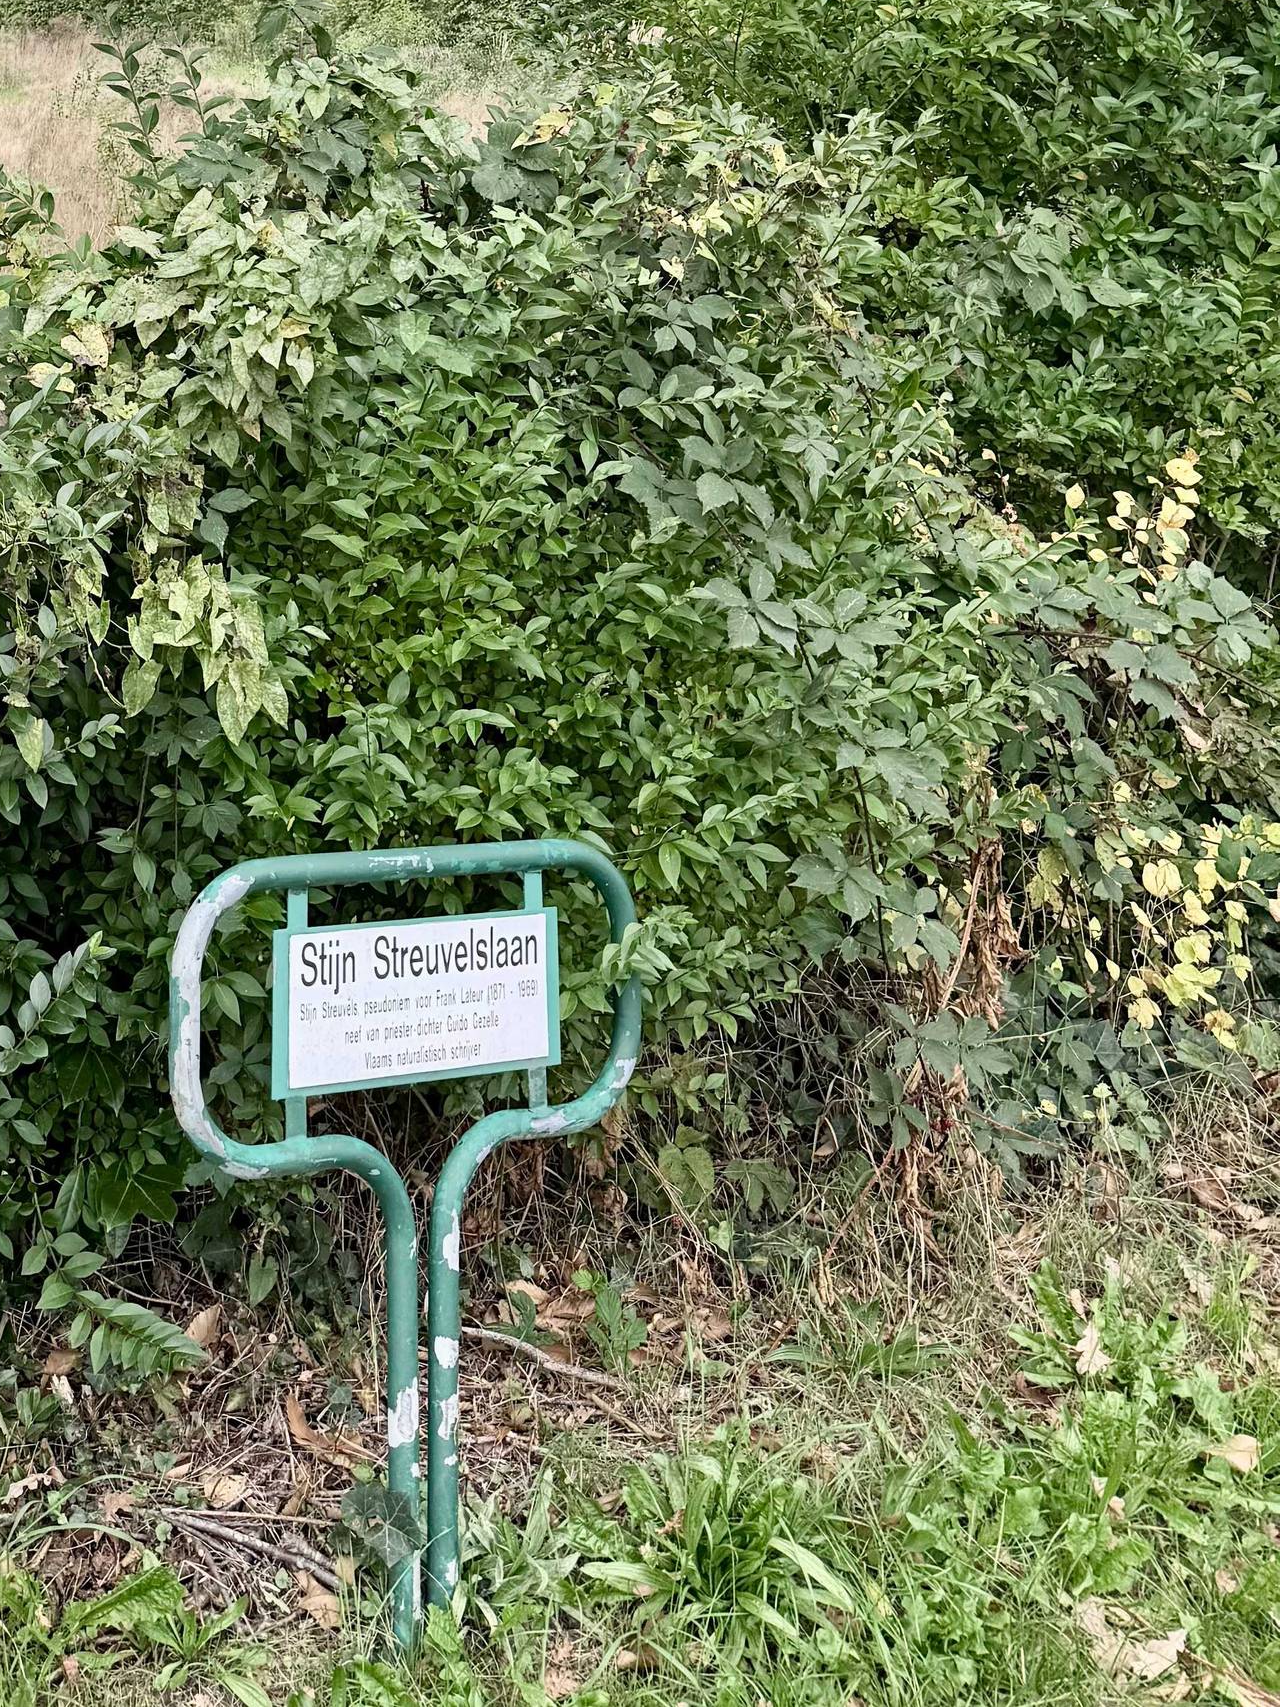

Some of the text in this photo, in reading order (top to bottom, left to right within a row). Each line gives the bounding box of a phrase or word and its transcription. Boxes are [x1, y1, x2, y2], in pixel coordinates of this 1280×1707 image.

[301, 926, 538, 995] Stijn Streuvelslaan
[300, 1003, 317, 1026] Stijn
[364, 993, 410, 1017] pseudoniem
[416, 995, 432, 1008] voor
[436, 988, 457, 1007] Frank
[460, 984, 484, 1004] Lateur
[487, 982, 506, 1005] (1871
[517, 979, 538, 997] 1969)
[345, 1010, 499, 1045] neef van priester-dichter Guido Gezelle
[365, 1040, 481, 1069] Vlaams naturalistisch schrijver
